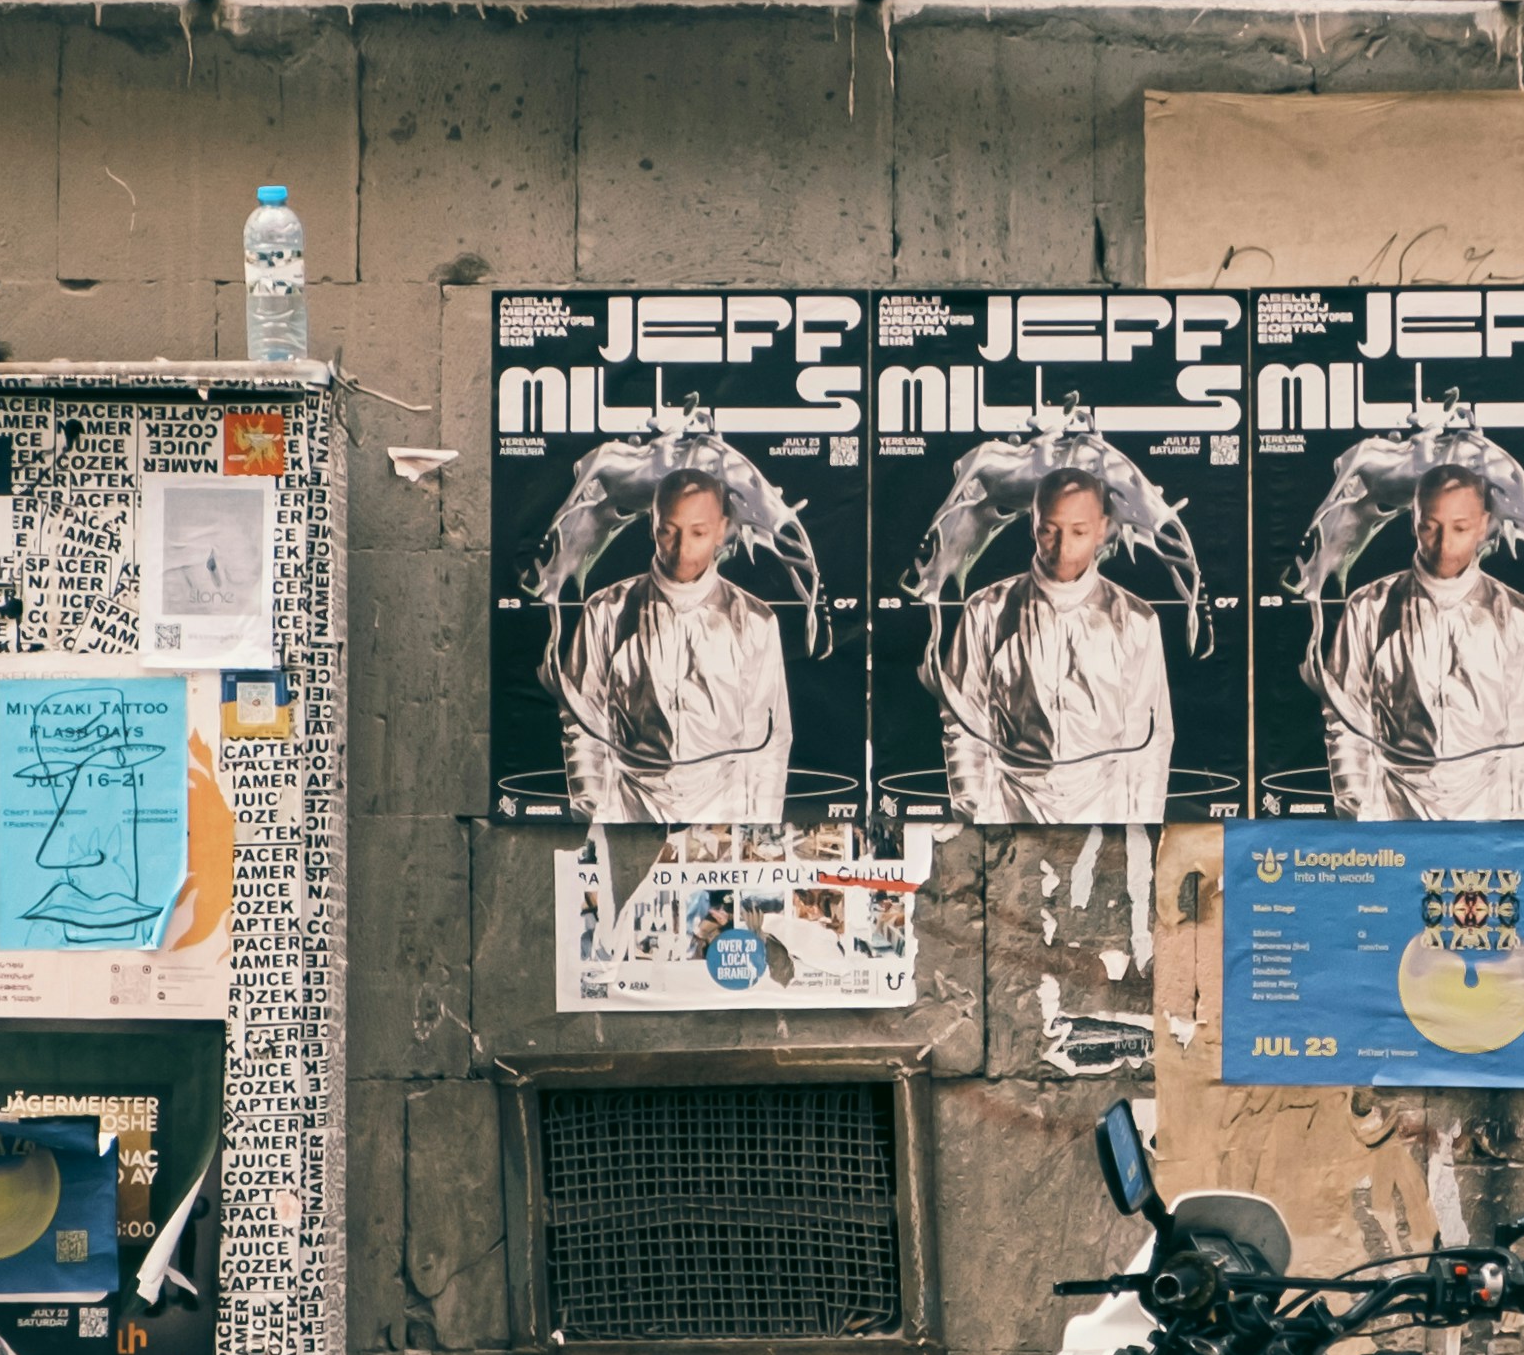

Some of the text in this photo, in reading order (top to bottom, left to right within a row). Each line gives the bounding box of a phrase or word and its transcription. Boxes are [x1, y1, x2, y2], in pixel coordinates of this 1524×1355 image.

[499, 316, 570, 326] DREAMY
[978, 295, 1241, 361] JEFF
[598, 296, 861, 362] JEFF
[499, 366, 861, 433] MILLS
[878, 365, 1241, 432] MILLS
[146, 424, 218, 438] COZEK
[149, 441, 212, 455] JUICE
[783, 437, 807, 446] JULY
[769, 447, 821, 456] SATURDAY
[56, 455, 129, 471] COZEK
[143, 458, 218, 473] NAMER
[189, 588, 234, 604] stone
[834, 598, 858, 609] 07
[6, 702, 168, 715] MIYAZAKI TATTOO
[96, 725, 144, 737] DAYS
[1294, 849, 1405, 870] Loopdeville
[1294, 873, 1375, 883] Into the woods
[717, 940, 757, 952] OVER 20
[721, 954, 750, 966] LOCAL
[1251, 1037, 1299, 1057] JUL
[1305, 1037, 1337, 1057] 23
[1, 1091, 159, 1114] JÄGERMEISTER
[31, 1309, 69, 1317] JULY 23
[17, 1318, 69, 1327] SATURDAY
